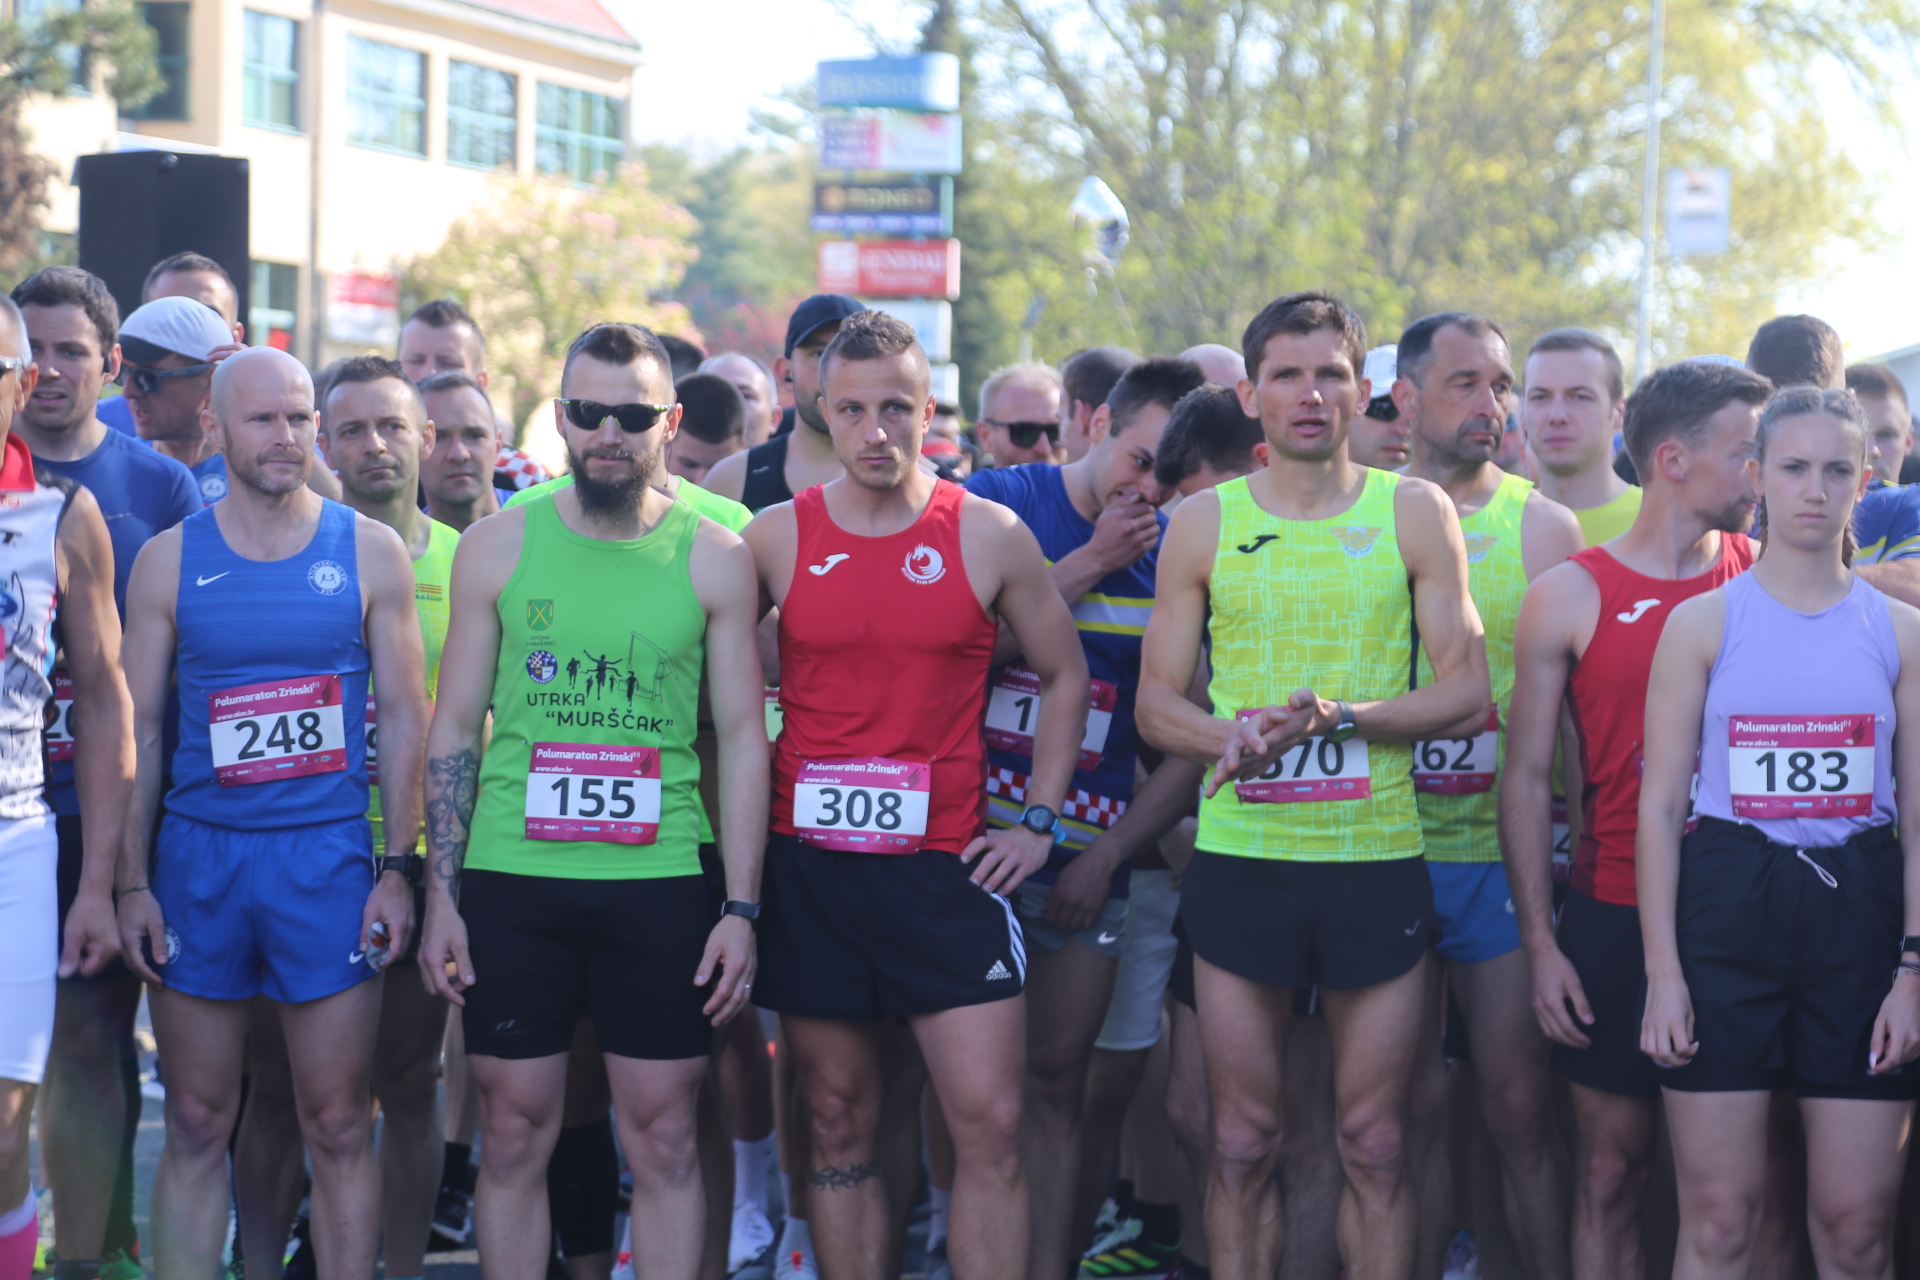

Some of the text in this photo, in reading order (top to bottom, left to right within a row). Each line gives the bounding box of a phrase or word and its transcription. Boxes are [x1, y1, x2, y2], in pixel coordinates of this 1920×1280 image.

[214, 683, 315, 708] Polumaraton Zrinski
[527, 692, 586, 706] UTRKA
[234, 711, 323, 761] 248
[1736, 721, 1844, 733] Polumaraton Zrinski
[535, 748, 634, 763] Polumaraton Zrinski
[806, 762, 901, 775] Polumaraton Zrinski
[1755, 750, 1849, 793] 183
[550, 776, 636, 819] 155
[816, 786, 902, 831] 308
[986, 971, 1012, 980] adidas
